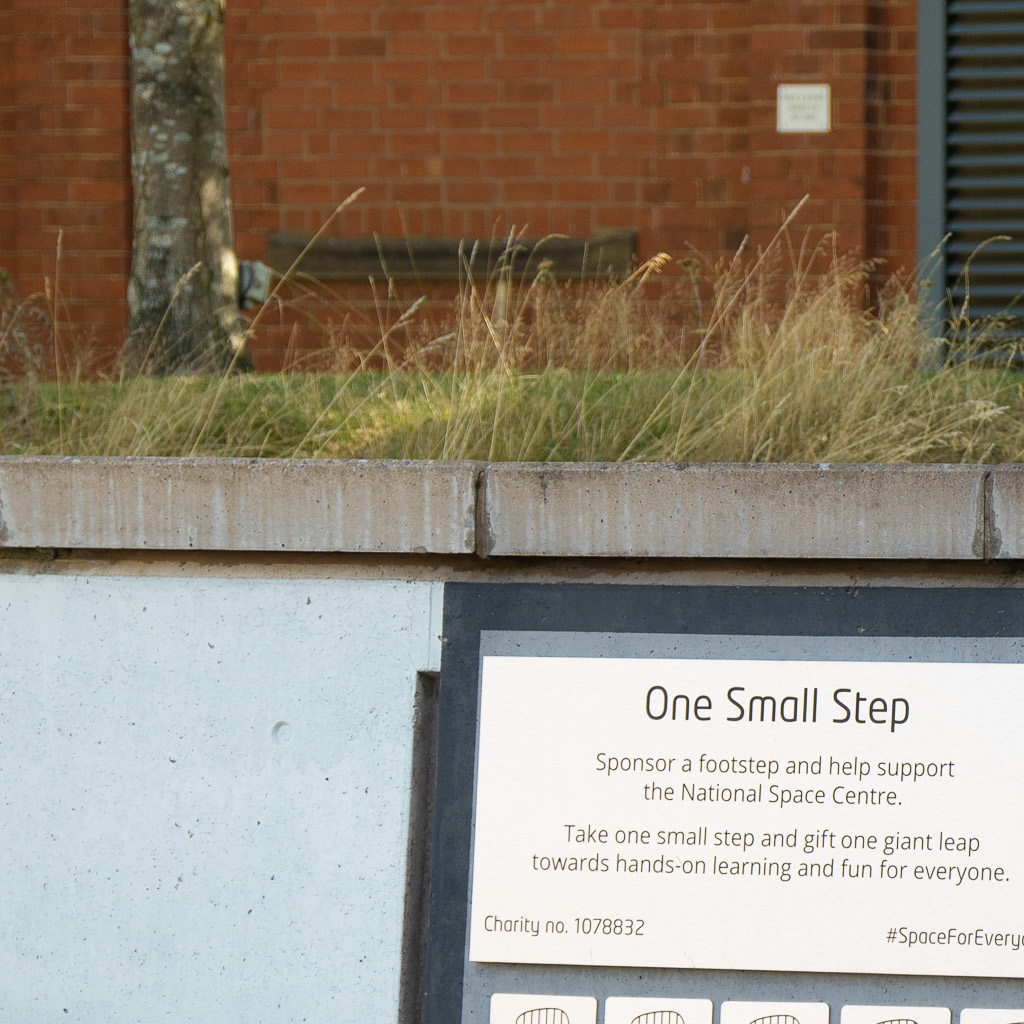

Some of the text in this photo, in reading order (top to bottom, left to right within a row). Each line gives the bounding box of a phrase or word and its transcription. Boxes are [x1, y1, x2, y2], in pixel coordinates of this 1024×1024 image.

[645, 685, 910, 733] One Small Step
[596, 752, 955, 783] Sponsor a footstep and help support
[643, 781, 902, 809] the National Space Centre.
[563, 823, 980, 858] Take one small step and gift one giant leap
[532, 852, 1010, 887] towards hands-on learning and fun for everyone.
[484, 915, 645, 937] Charity no. 1078832
